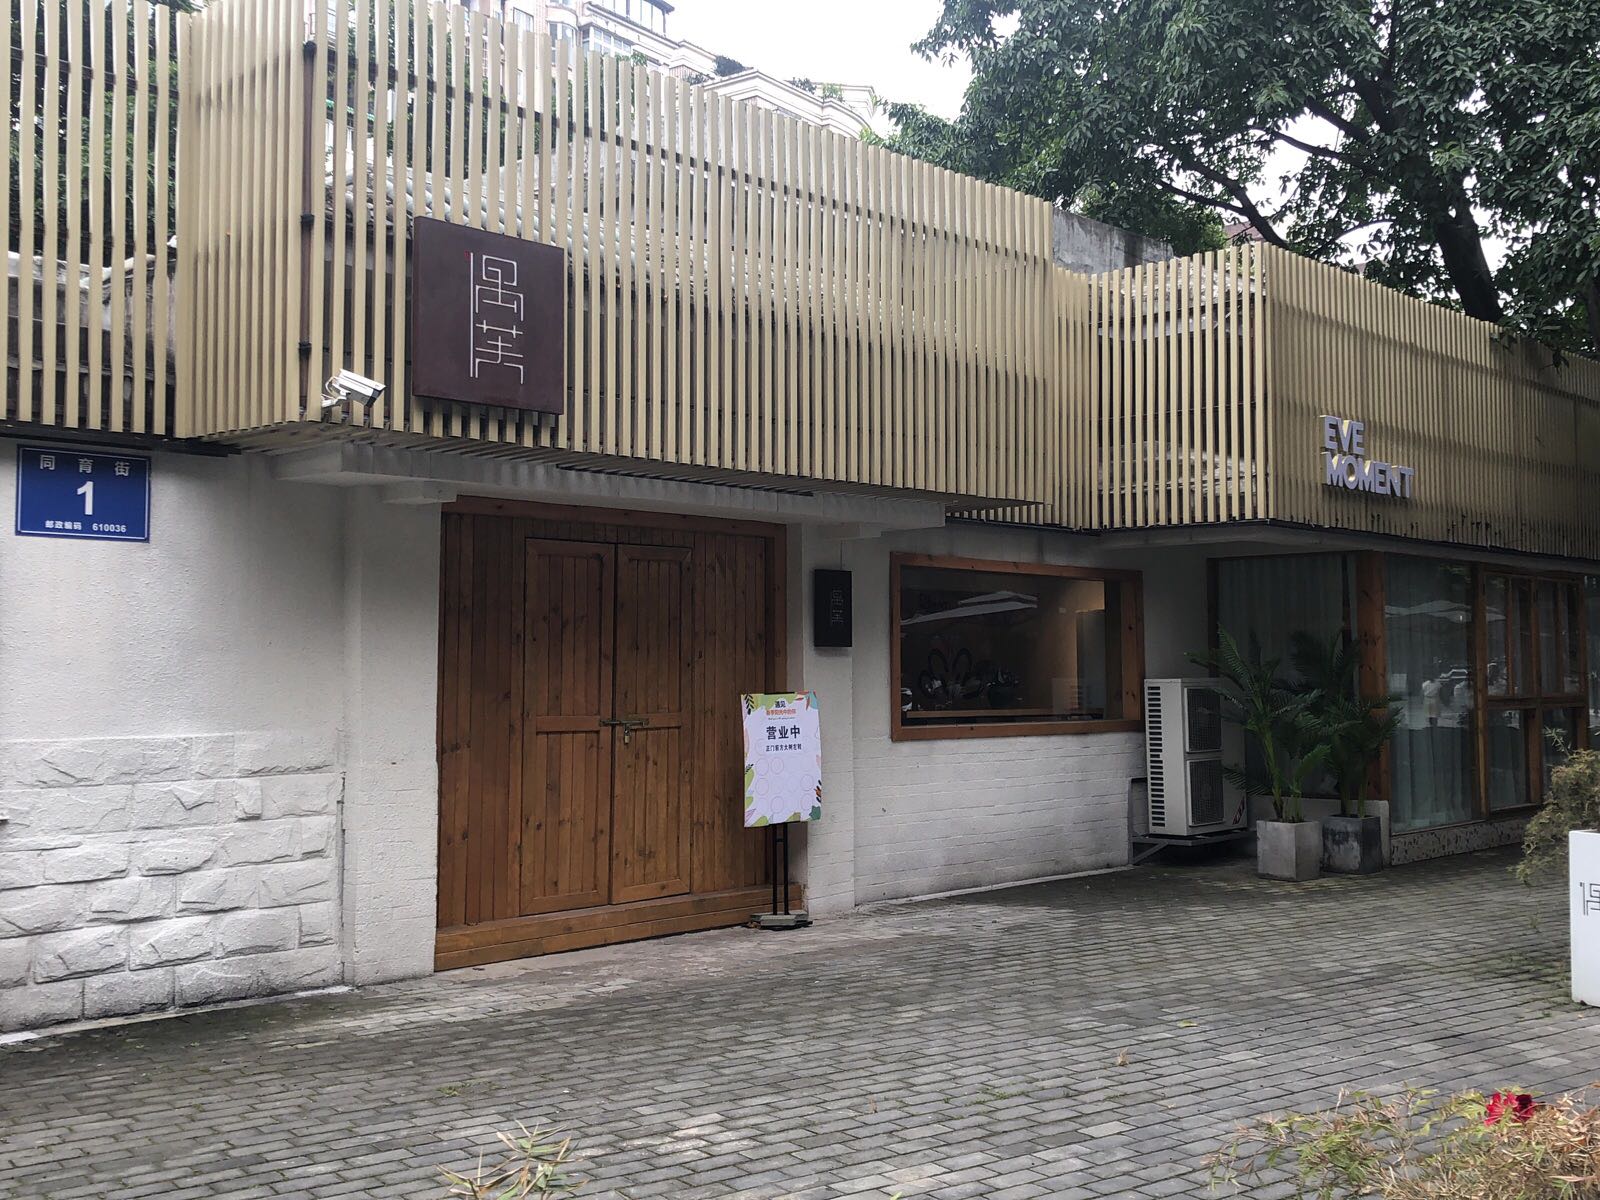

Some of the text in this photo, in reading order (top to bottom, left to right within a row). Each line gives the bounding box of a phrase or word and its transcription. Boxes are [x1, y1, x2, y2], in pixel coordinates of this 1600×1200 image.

[1320, 415, 1364, 455] EVE
[40, 455, 130, 476] 同育街
[1320, 452, 1414, 498] MOMENT
[77, 480, 94, 515] 1
[45, 520, 127, 533] 邮政编码 610036
[766, 725, 800, 740] 营业中
